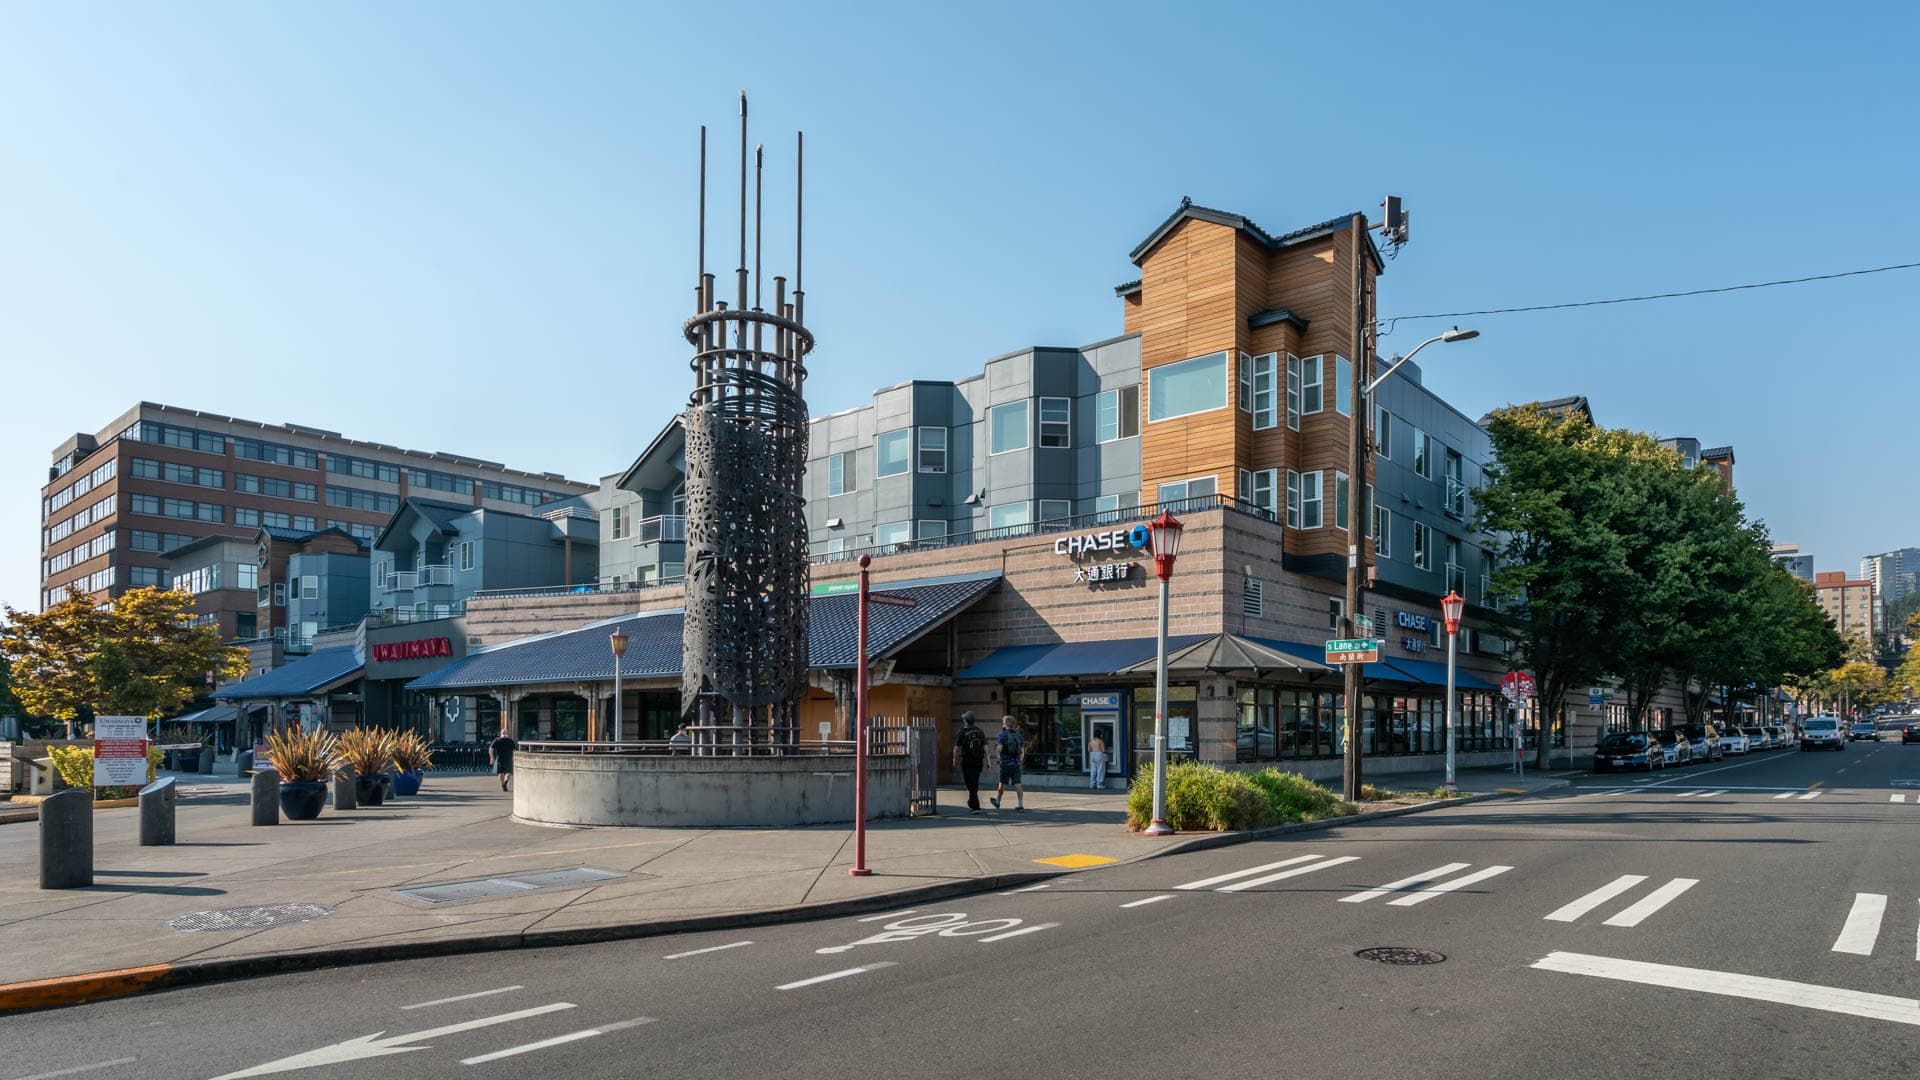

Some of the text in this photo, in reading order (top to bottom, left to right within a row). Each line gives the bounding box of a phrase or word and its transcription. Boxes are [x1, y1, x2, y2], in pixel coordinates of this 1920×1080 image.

[1055, 530, 1126, 555] CHASE
[1073, 562, 1129, 583] 大通銀行
[1399, 611, 1427, 632] CHASE
[372, 637, 452, 662] UWAJIMAYA
[1334, 640, 1353, 651] Lane
[1082, 697, 1110, 705] CHASE
